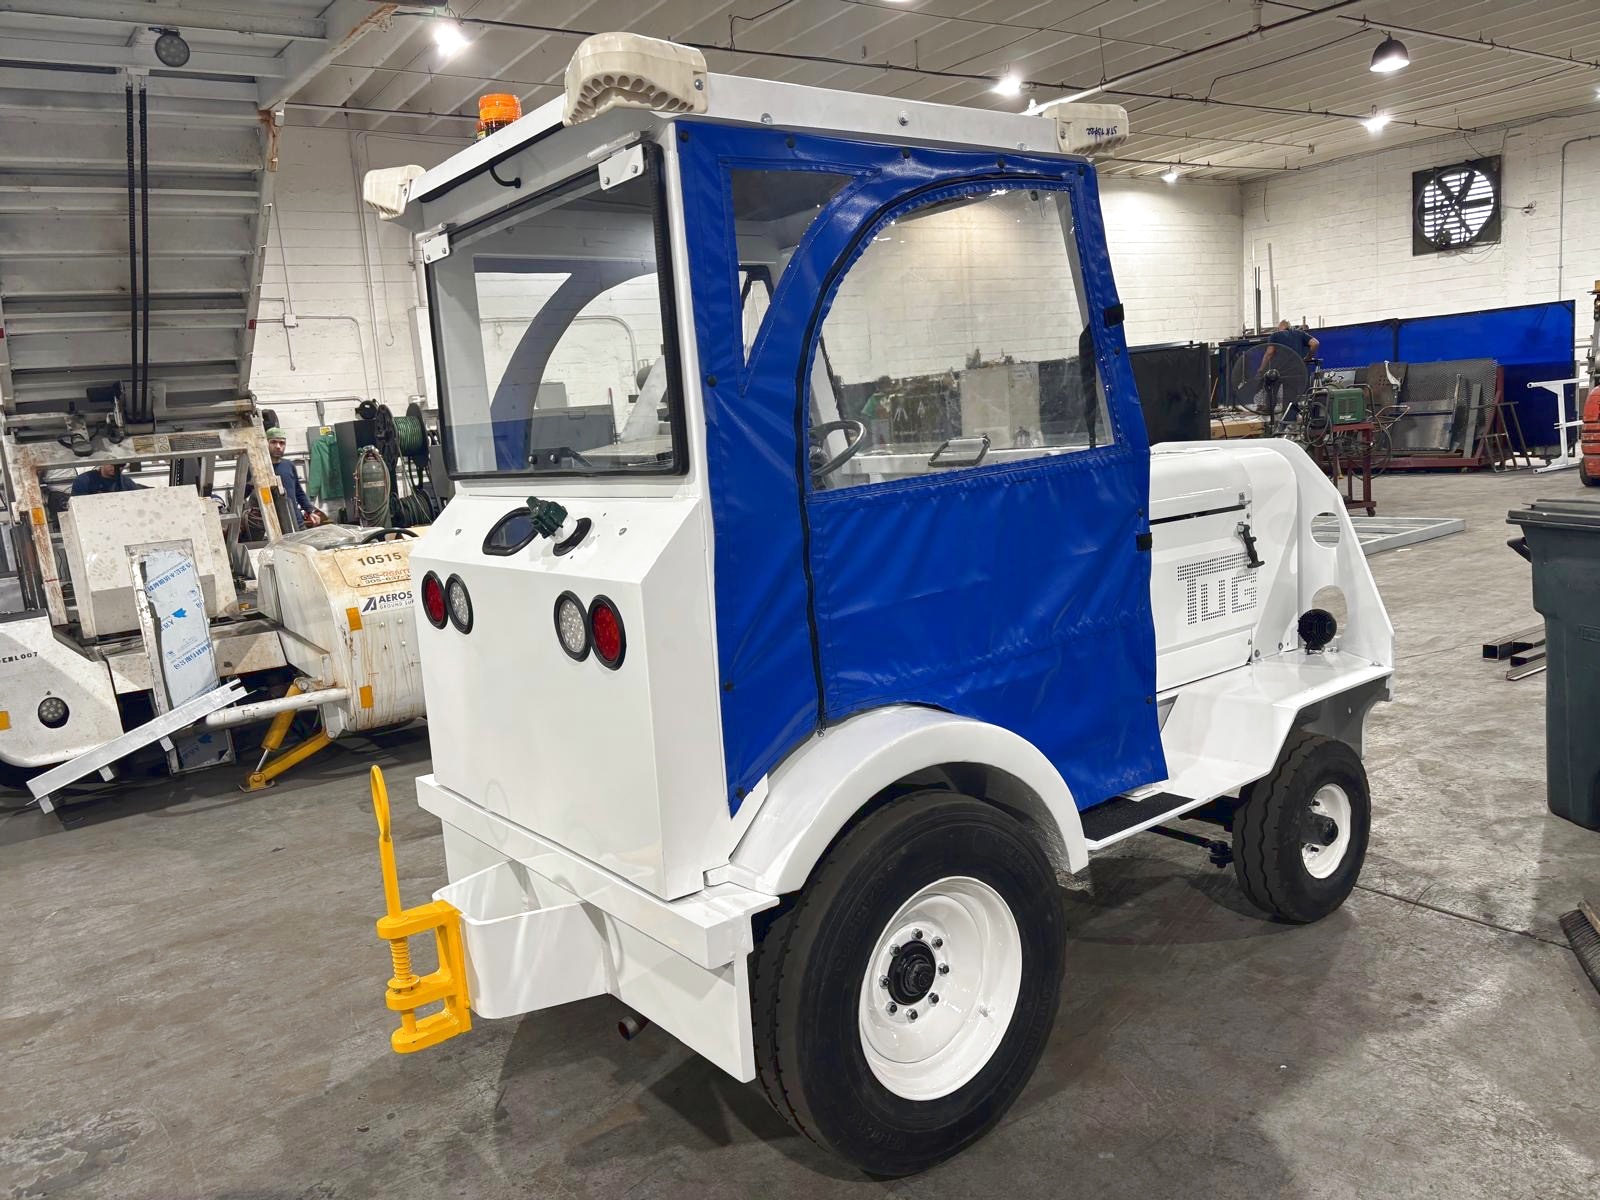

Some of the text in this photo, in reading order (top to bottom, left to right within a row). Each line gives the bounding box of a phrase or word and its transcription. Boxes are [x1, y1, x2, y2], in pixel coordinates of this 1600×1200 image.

[358, 552, 402, 566] 10515
[1177, 552, 1257, 625] TUG
[378, 590, 412, 603] AEROS
